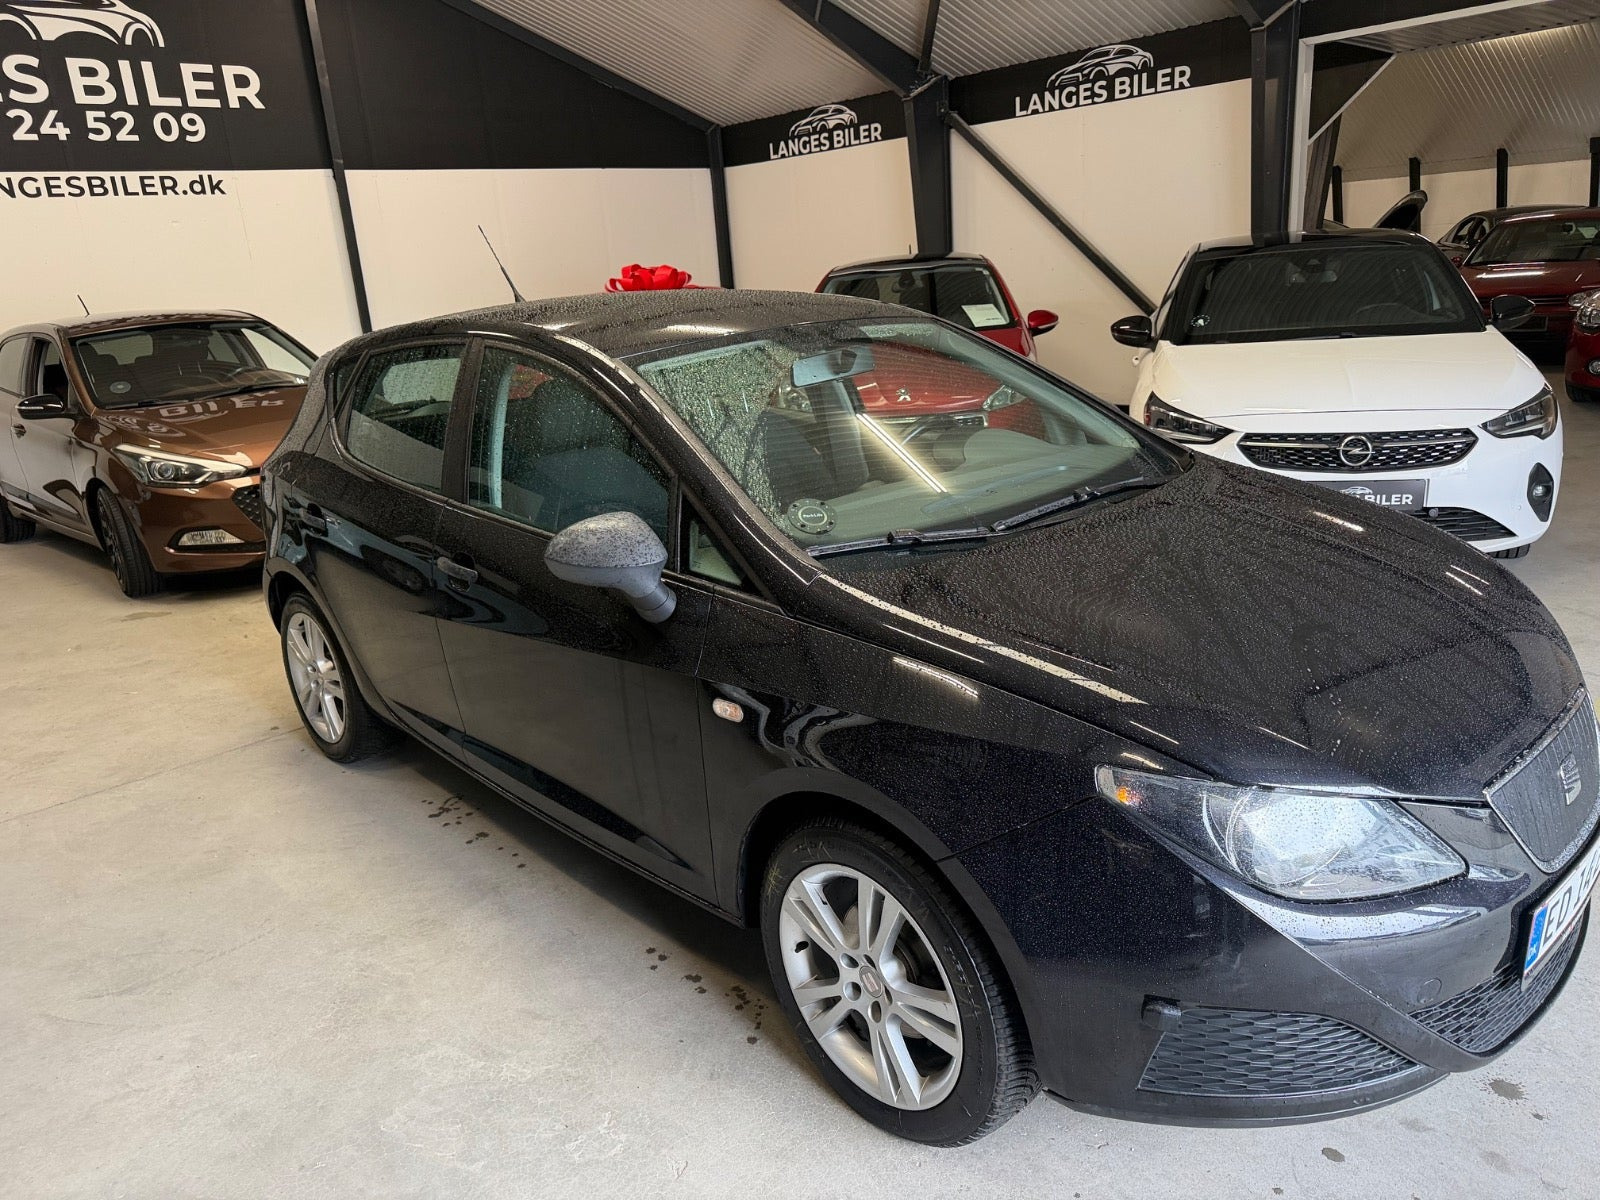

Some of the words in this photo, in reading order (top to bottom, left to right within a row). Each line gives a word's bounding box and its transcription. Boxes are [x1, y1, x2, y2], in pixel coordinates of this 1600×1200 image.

[0, 54, 50, 104] S
[65, 57, 266, 109] BILER
[1015, 80, 1108, 117] LANGES
[1114, 65, 1191, 100] BILER
[5, 108, 71, 141] 24
[85, 110, 140, 142] 52
[153, 112, 206, 143] 09
[769, 132, 830, 160] LANGES
[833, 122, 882, 149] BILER
[1364, 494, 1413, 506] BILER
